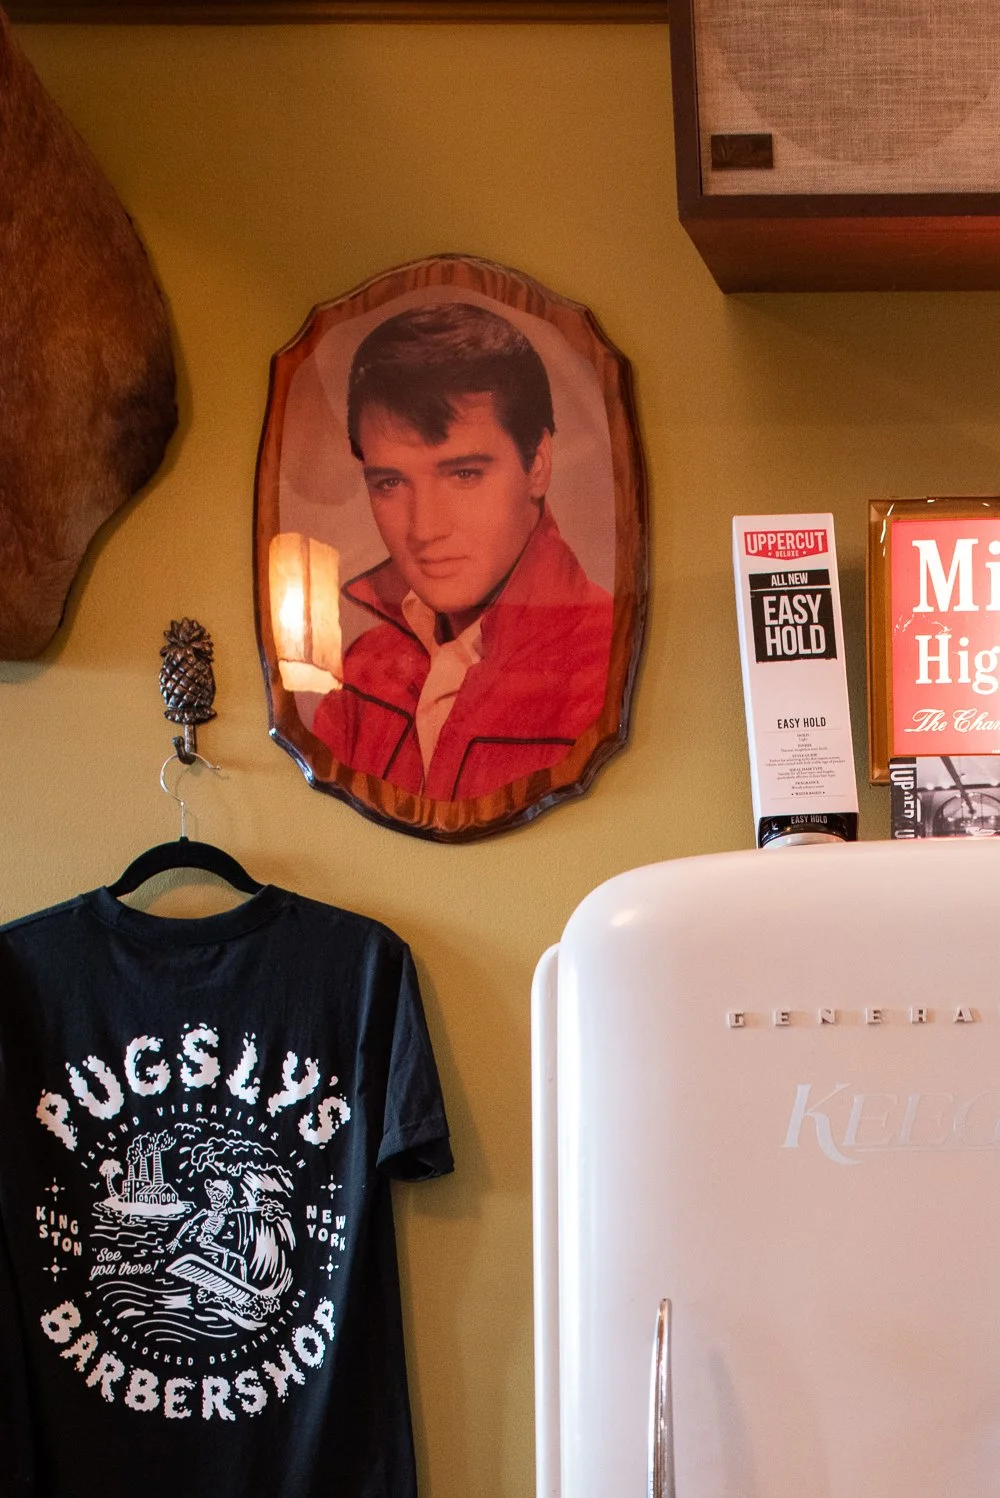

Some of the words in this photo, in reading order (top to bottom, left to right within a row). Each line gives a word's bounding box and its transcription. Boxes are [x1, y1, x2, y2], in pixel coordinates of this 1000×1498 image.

[746, 532, 825, 554] UPPERCUT
[775, 550, 800, 558] DELUXE
[771, 574, 787, 587] ALL
[788, 572, 808, 585] NEW
[763, 594, 822, 625] EASY
[765, 625, 826, 657] HOLD
[777, 718, 801, 730] EASY
[803, 716, 827, 728] HOLD
[904, 708, 949, 733] The
[790, 815, 808, 825] EASY
[810, 814, 828, 824] HOLD
[81, 1115, 140, 1169] ISLAND
[157, 1105, 280, 1141] VIBRATIONS
[289, 1150, 307, 1169] IN
[35, 1206, 79, 1235] KING
[306, 1204, 347, 1230] NEW
[38, 1223, 83, 1257] STON
[306, 1224, 347, 1252] YORK
[89, 1264, 116, 1281] you
[85, 1290, 92, 1298] A
[95, 1309, 194, 1366] LANDLOCKED
[209, 1289, 306, 1365] DESTINATION
[39, 1297, 336, 1421] BARBERSHOP
